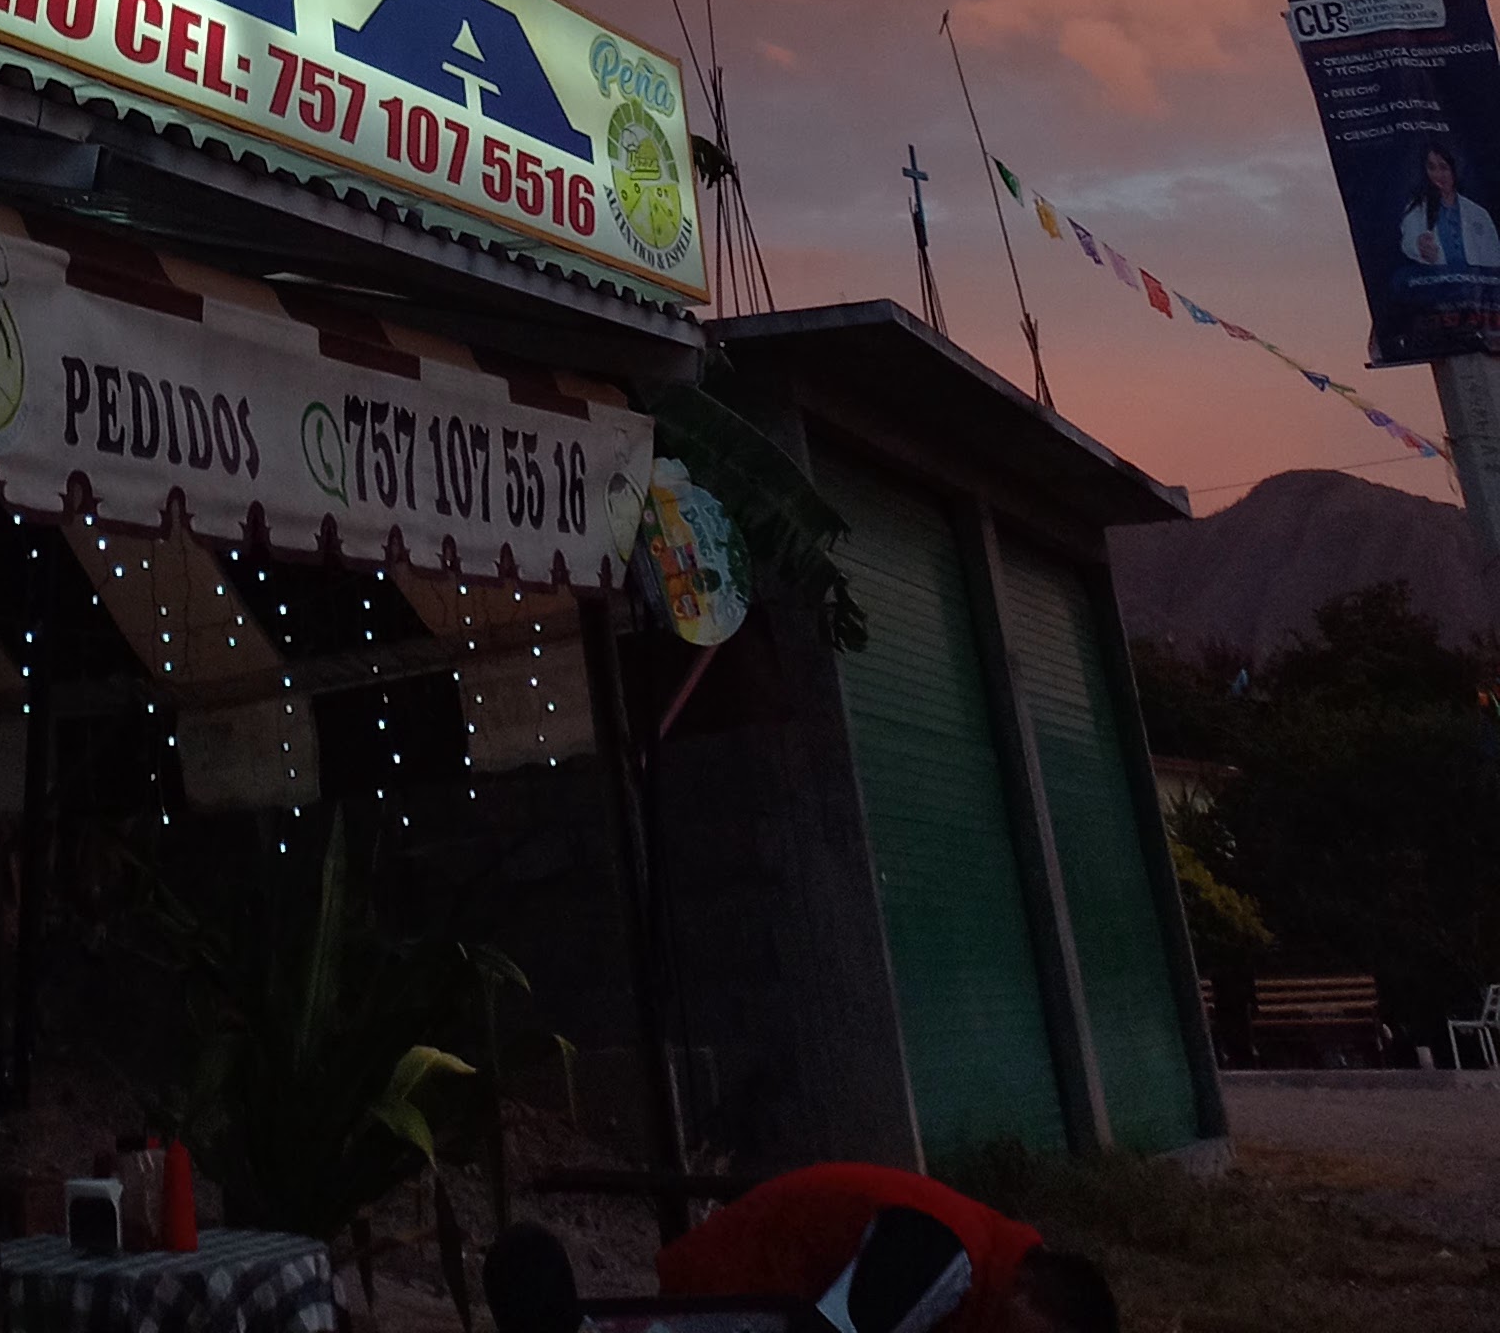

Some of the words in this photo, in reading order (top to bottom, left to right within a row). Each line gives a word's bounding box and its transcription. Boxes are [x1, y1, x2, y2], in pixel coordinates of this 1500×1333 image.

[267, 43, 367, 144] 757
[379, 96, 470, 185] 107
[482, 135, 595, 237] 5516
[590, 36, 674, 115] Peña
[62, 355, 260, 480] PEDIDOS
[344, 394, 417, 511] 757
[428, 415, 491, 523] 107
[502, 427, 545, 531] 55
[553, 440, 587, 536] 16
